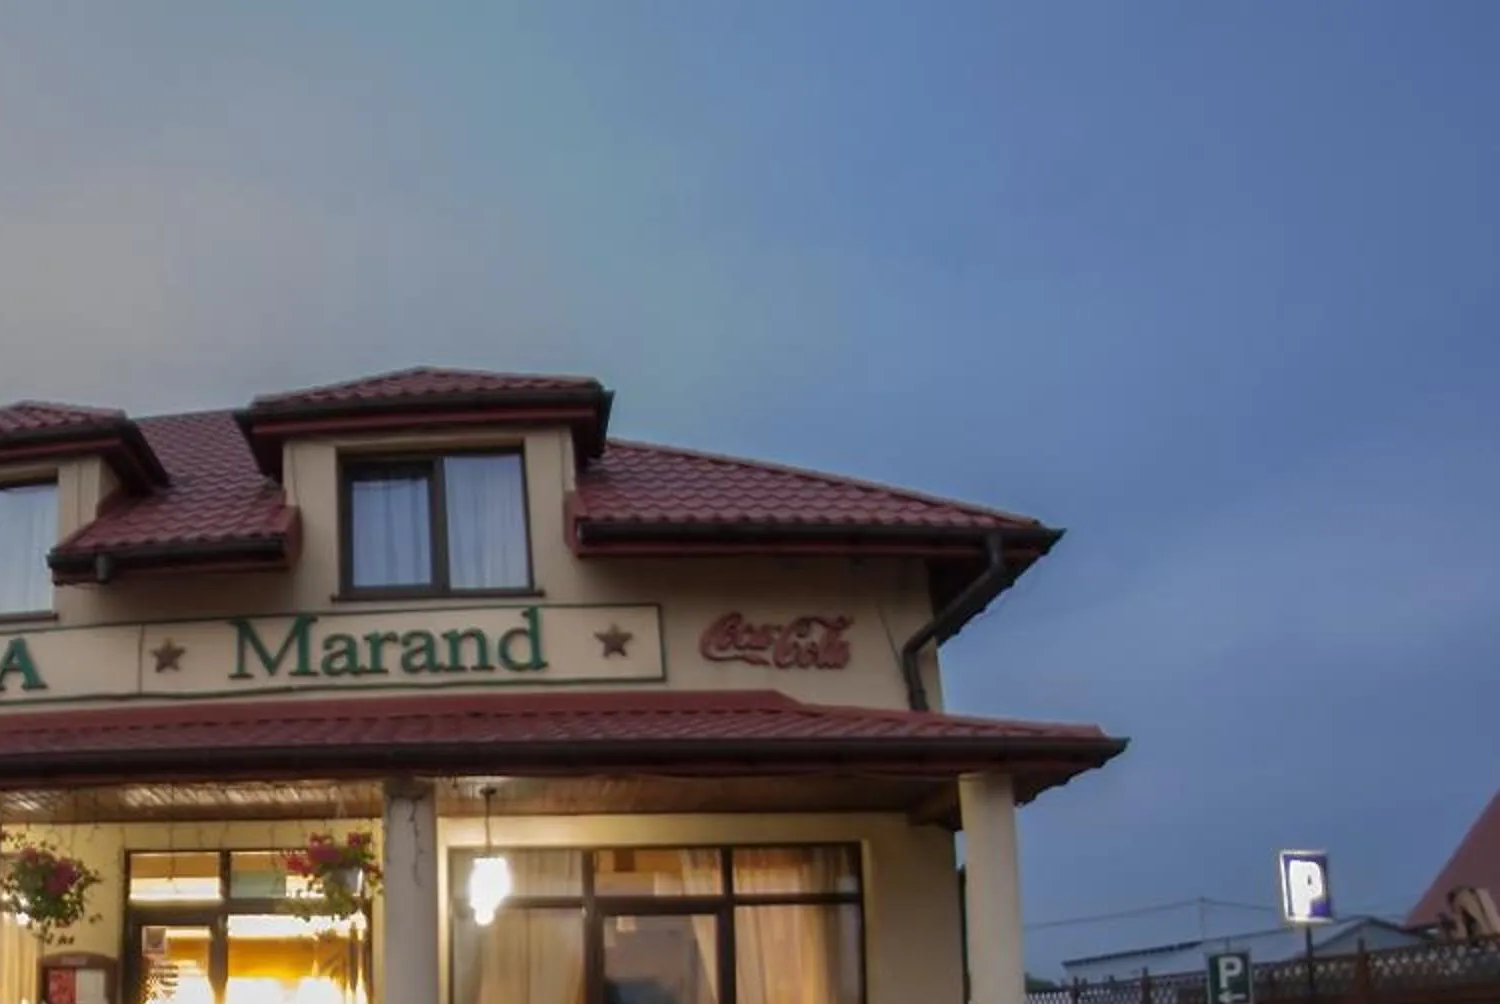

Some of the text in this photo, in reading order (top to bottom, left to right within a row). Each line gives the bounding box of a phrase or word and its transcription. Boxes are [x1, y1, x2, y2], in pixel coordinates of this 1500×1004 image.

[228, 608, 549, 679] Marand
[1288, 859, 1324, 918] P
[1218, 956, 1243, 988] P
